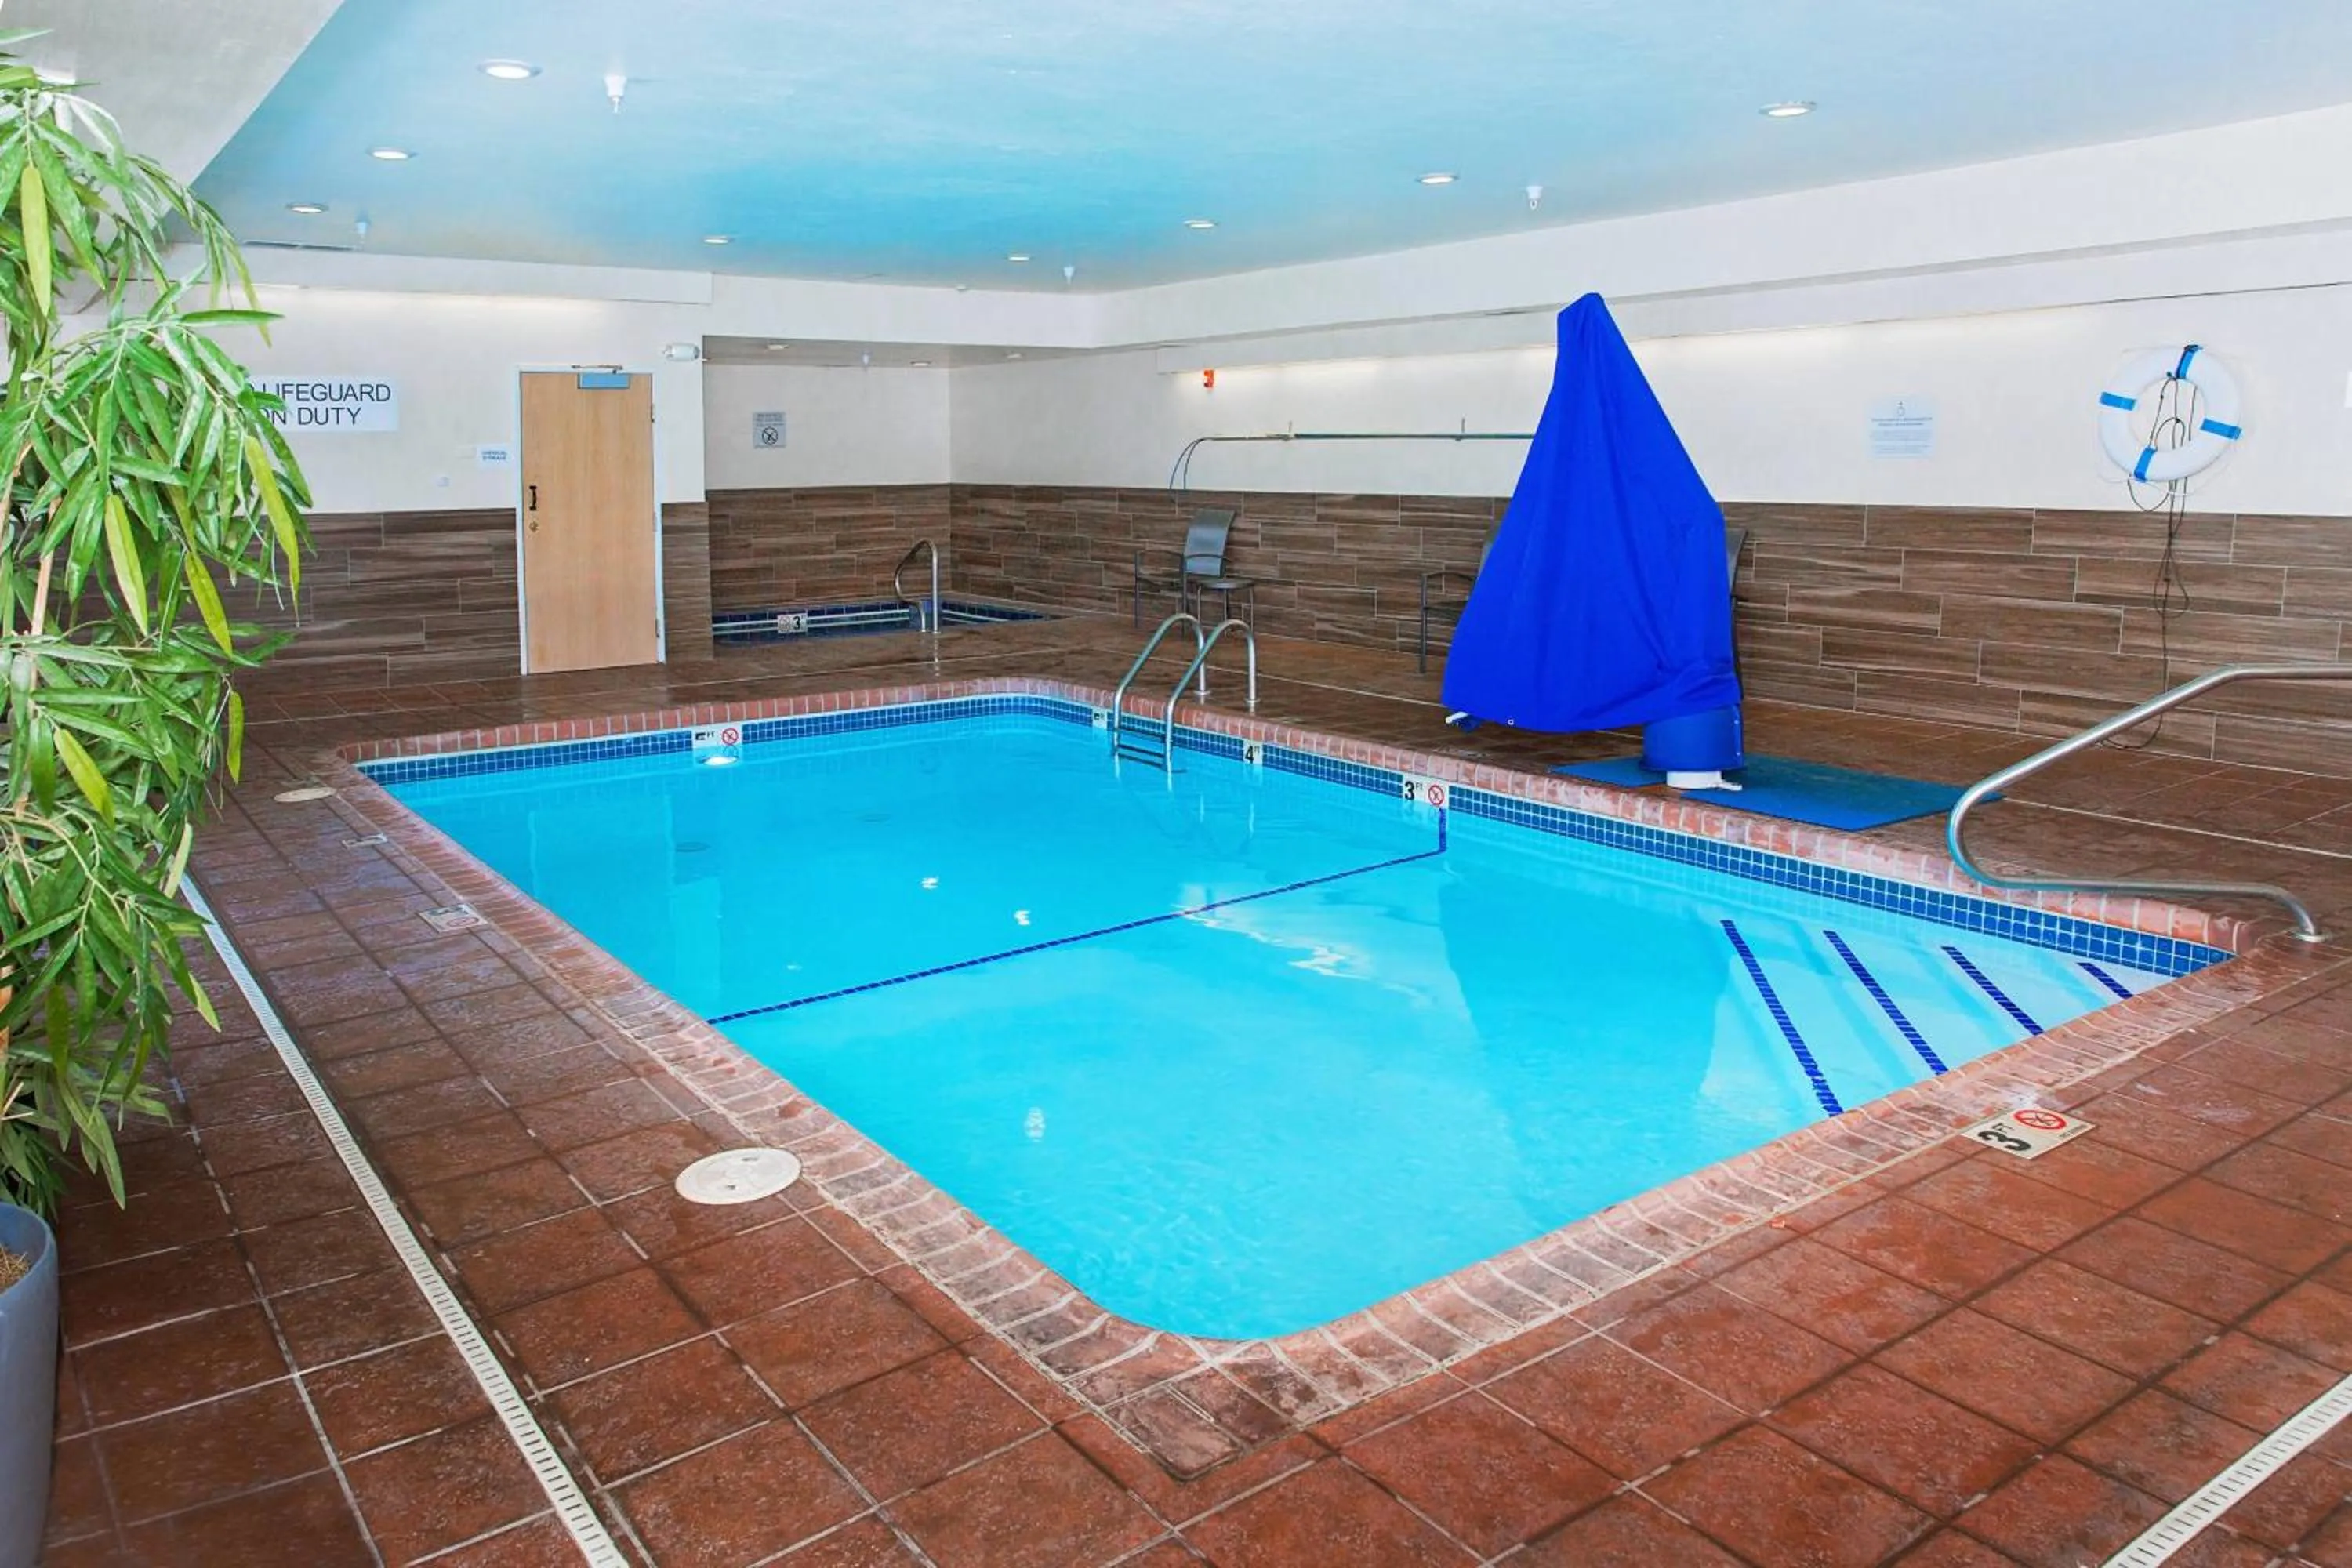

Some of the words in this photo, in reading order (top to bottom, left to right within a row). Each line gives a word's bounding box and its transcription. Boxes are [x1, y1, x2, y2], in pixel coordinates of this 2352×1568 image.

[297, 407, 361, 425] DUTY
[793, 615, 800, 630] 3
[1244, 746, 1254, 764] 4
[1404, 781, 1415, 800] 3
[1991, 1122, 2015, 1134] FT
[1977, 1131, 2032, 1152] 3
